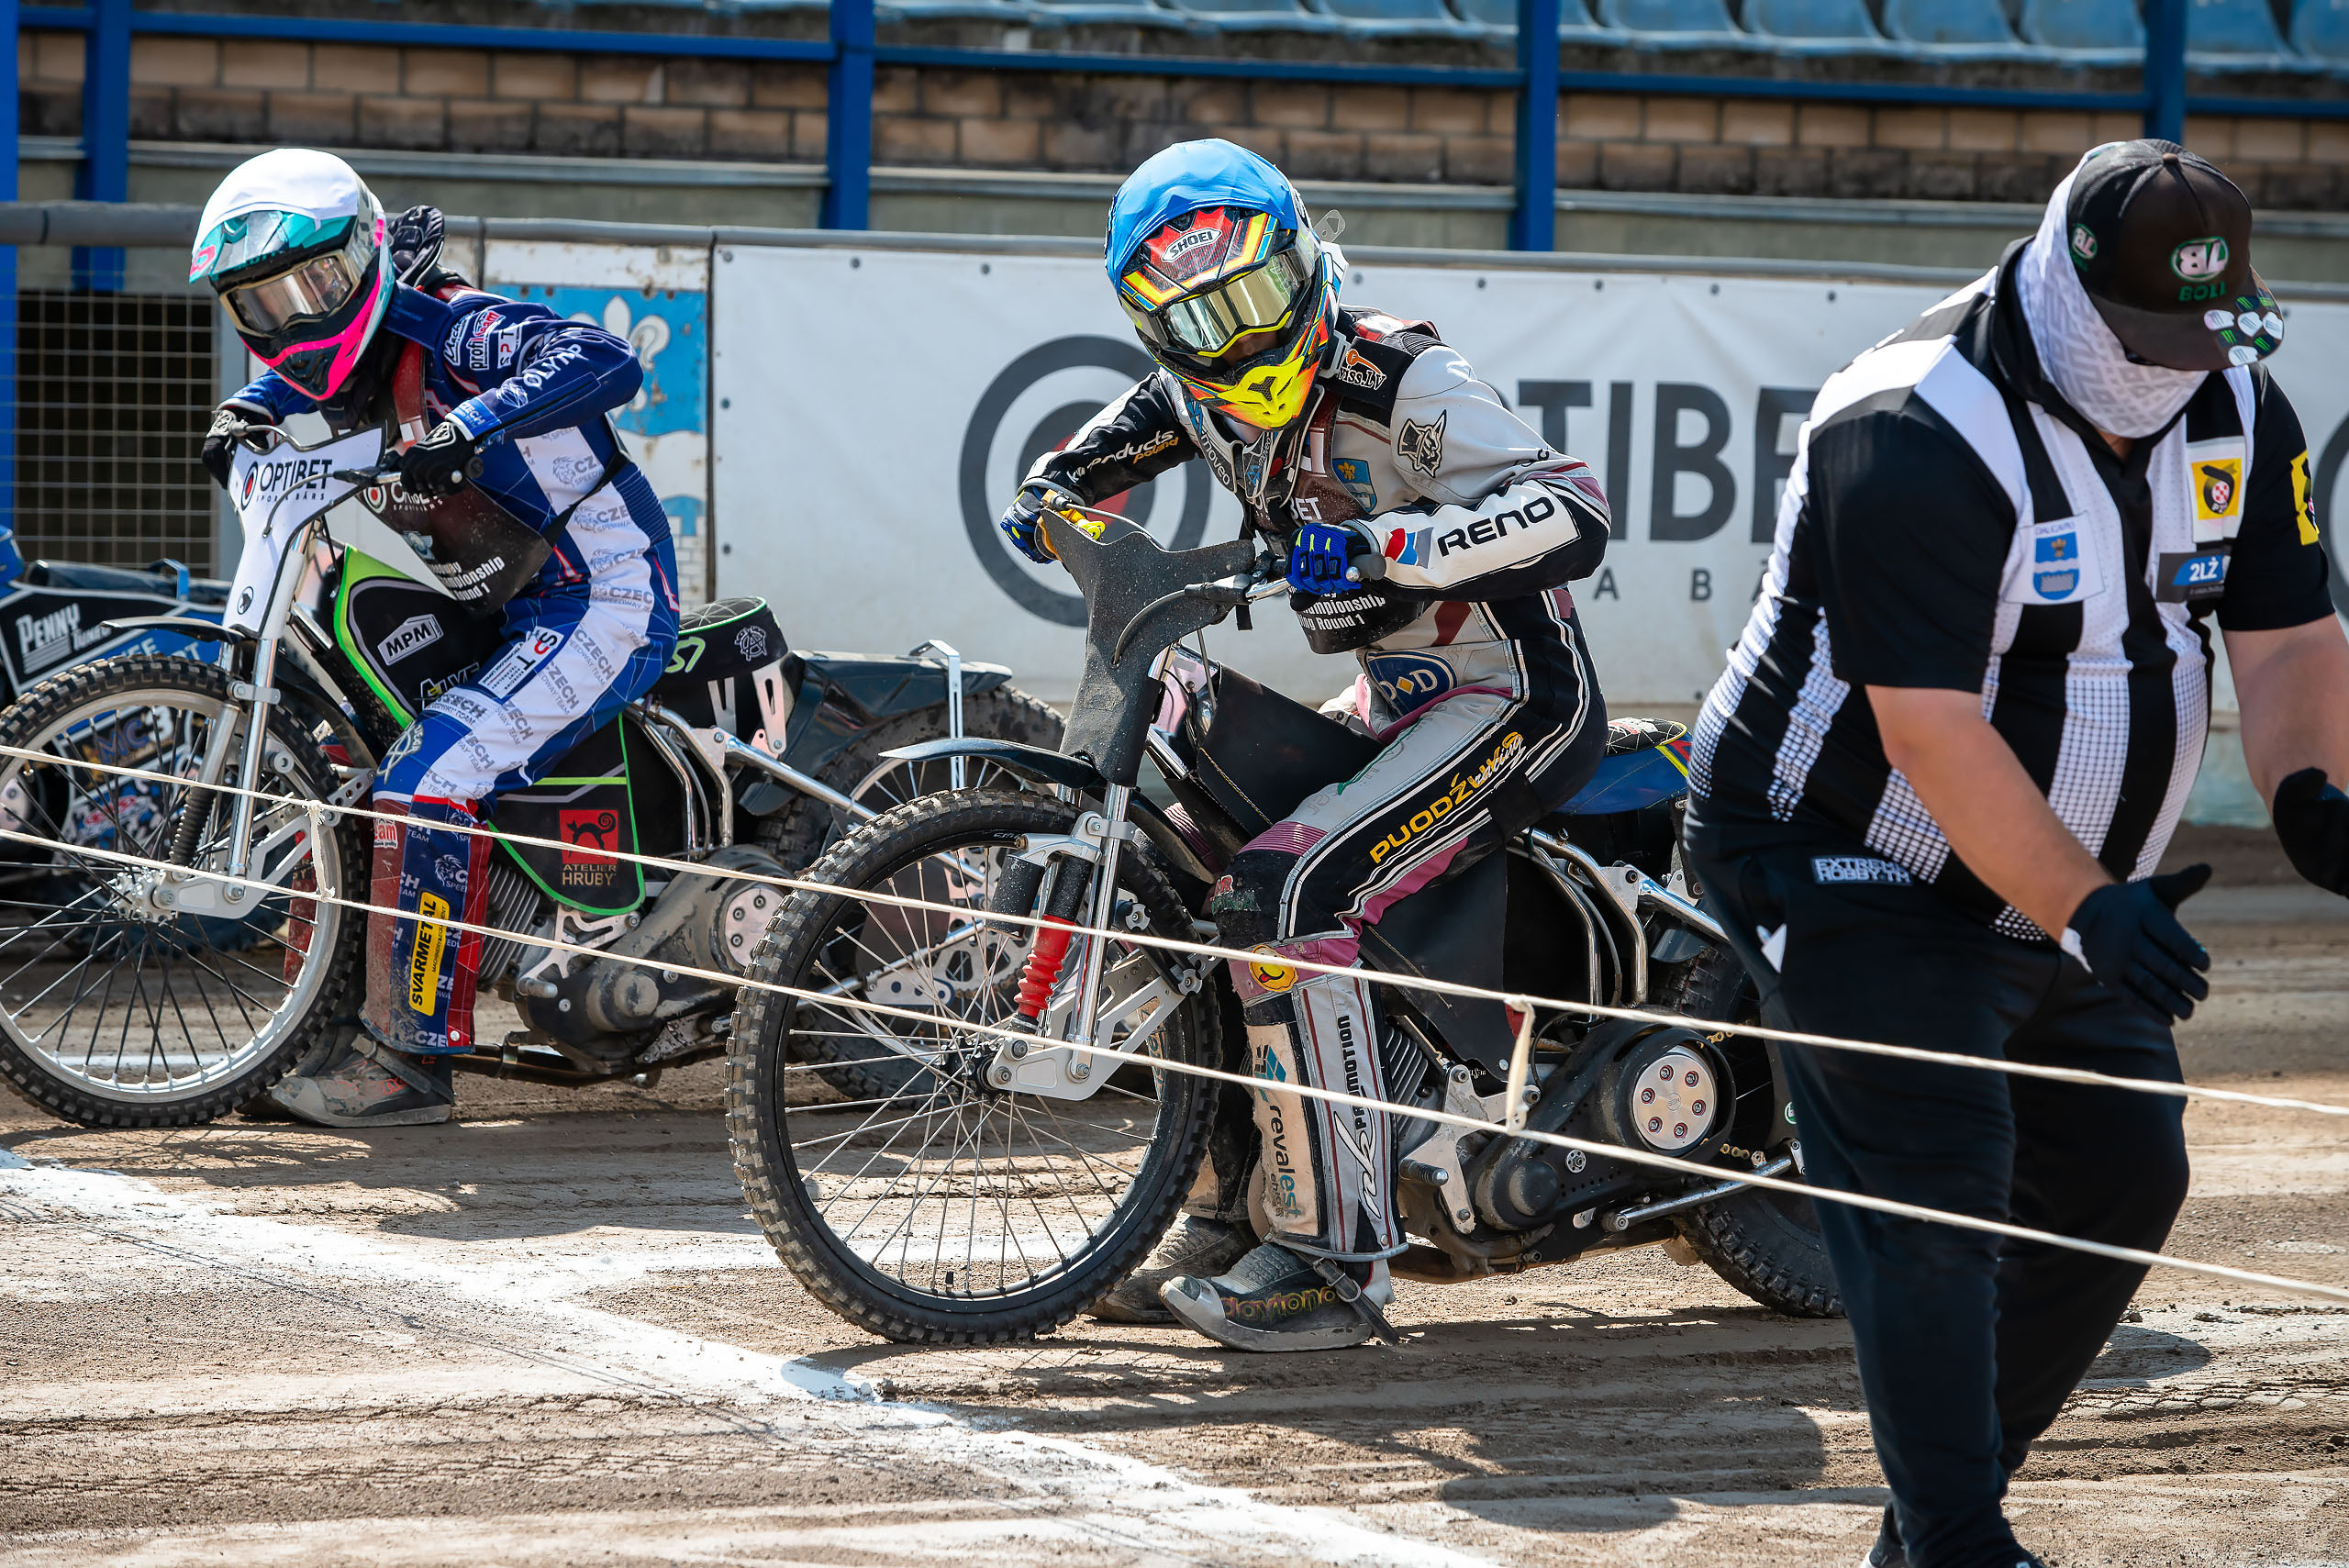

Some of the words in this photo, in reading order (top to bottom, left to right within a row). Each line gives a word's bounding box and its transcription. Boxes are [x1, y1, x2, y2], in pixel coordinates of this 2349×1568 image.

[1168, 231, 1213, 258] SHOEI
[1132, 436, 1180, 465] poland
[1516, 378, 1819, 544] TIBE
[261, 459, 332, 492] OPTIBET
[1437, 496, 1555, 557] RENO
[608, 586, 653, 605] CZEC
[16, 602, 82, 654] PENNY
[1316, 615, 1356, 630] Round
[1354, 613, 1366, 625] 1
[385, 622, 433, 658] MPM
[573, 628, 616, 681] CZECH
[504, 697, 534, 742] ZECH
[562, 862, 618, 873] ATELIER
[562, 872, 614, 887] HRUBY
[413, 900, 438, 1006] SVARMETAL
[414, 1029, 448, 1048] CZE
[1337, 1014, 1367, 1130] PRMOTION
[1269, 1104, 1303, 1218] revalest
